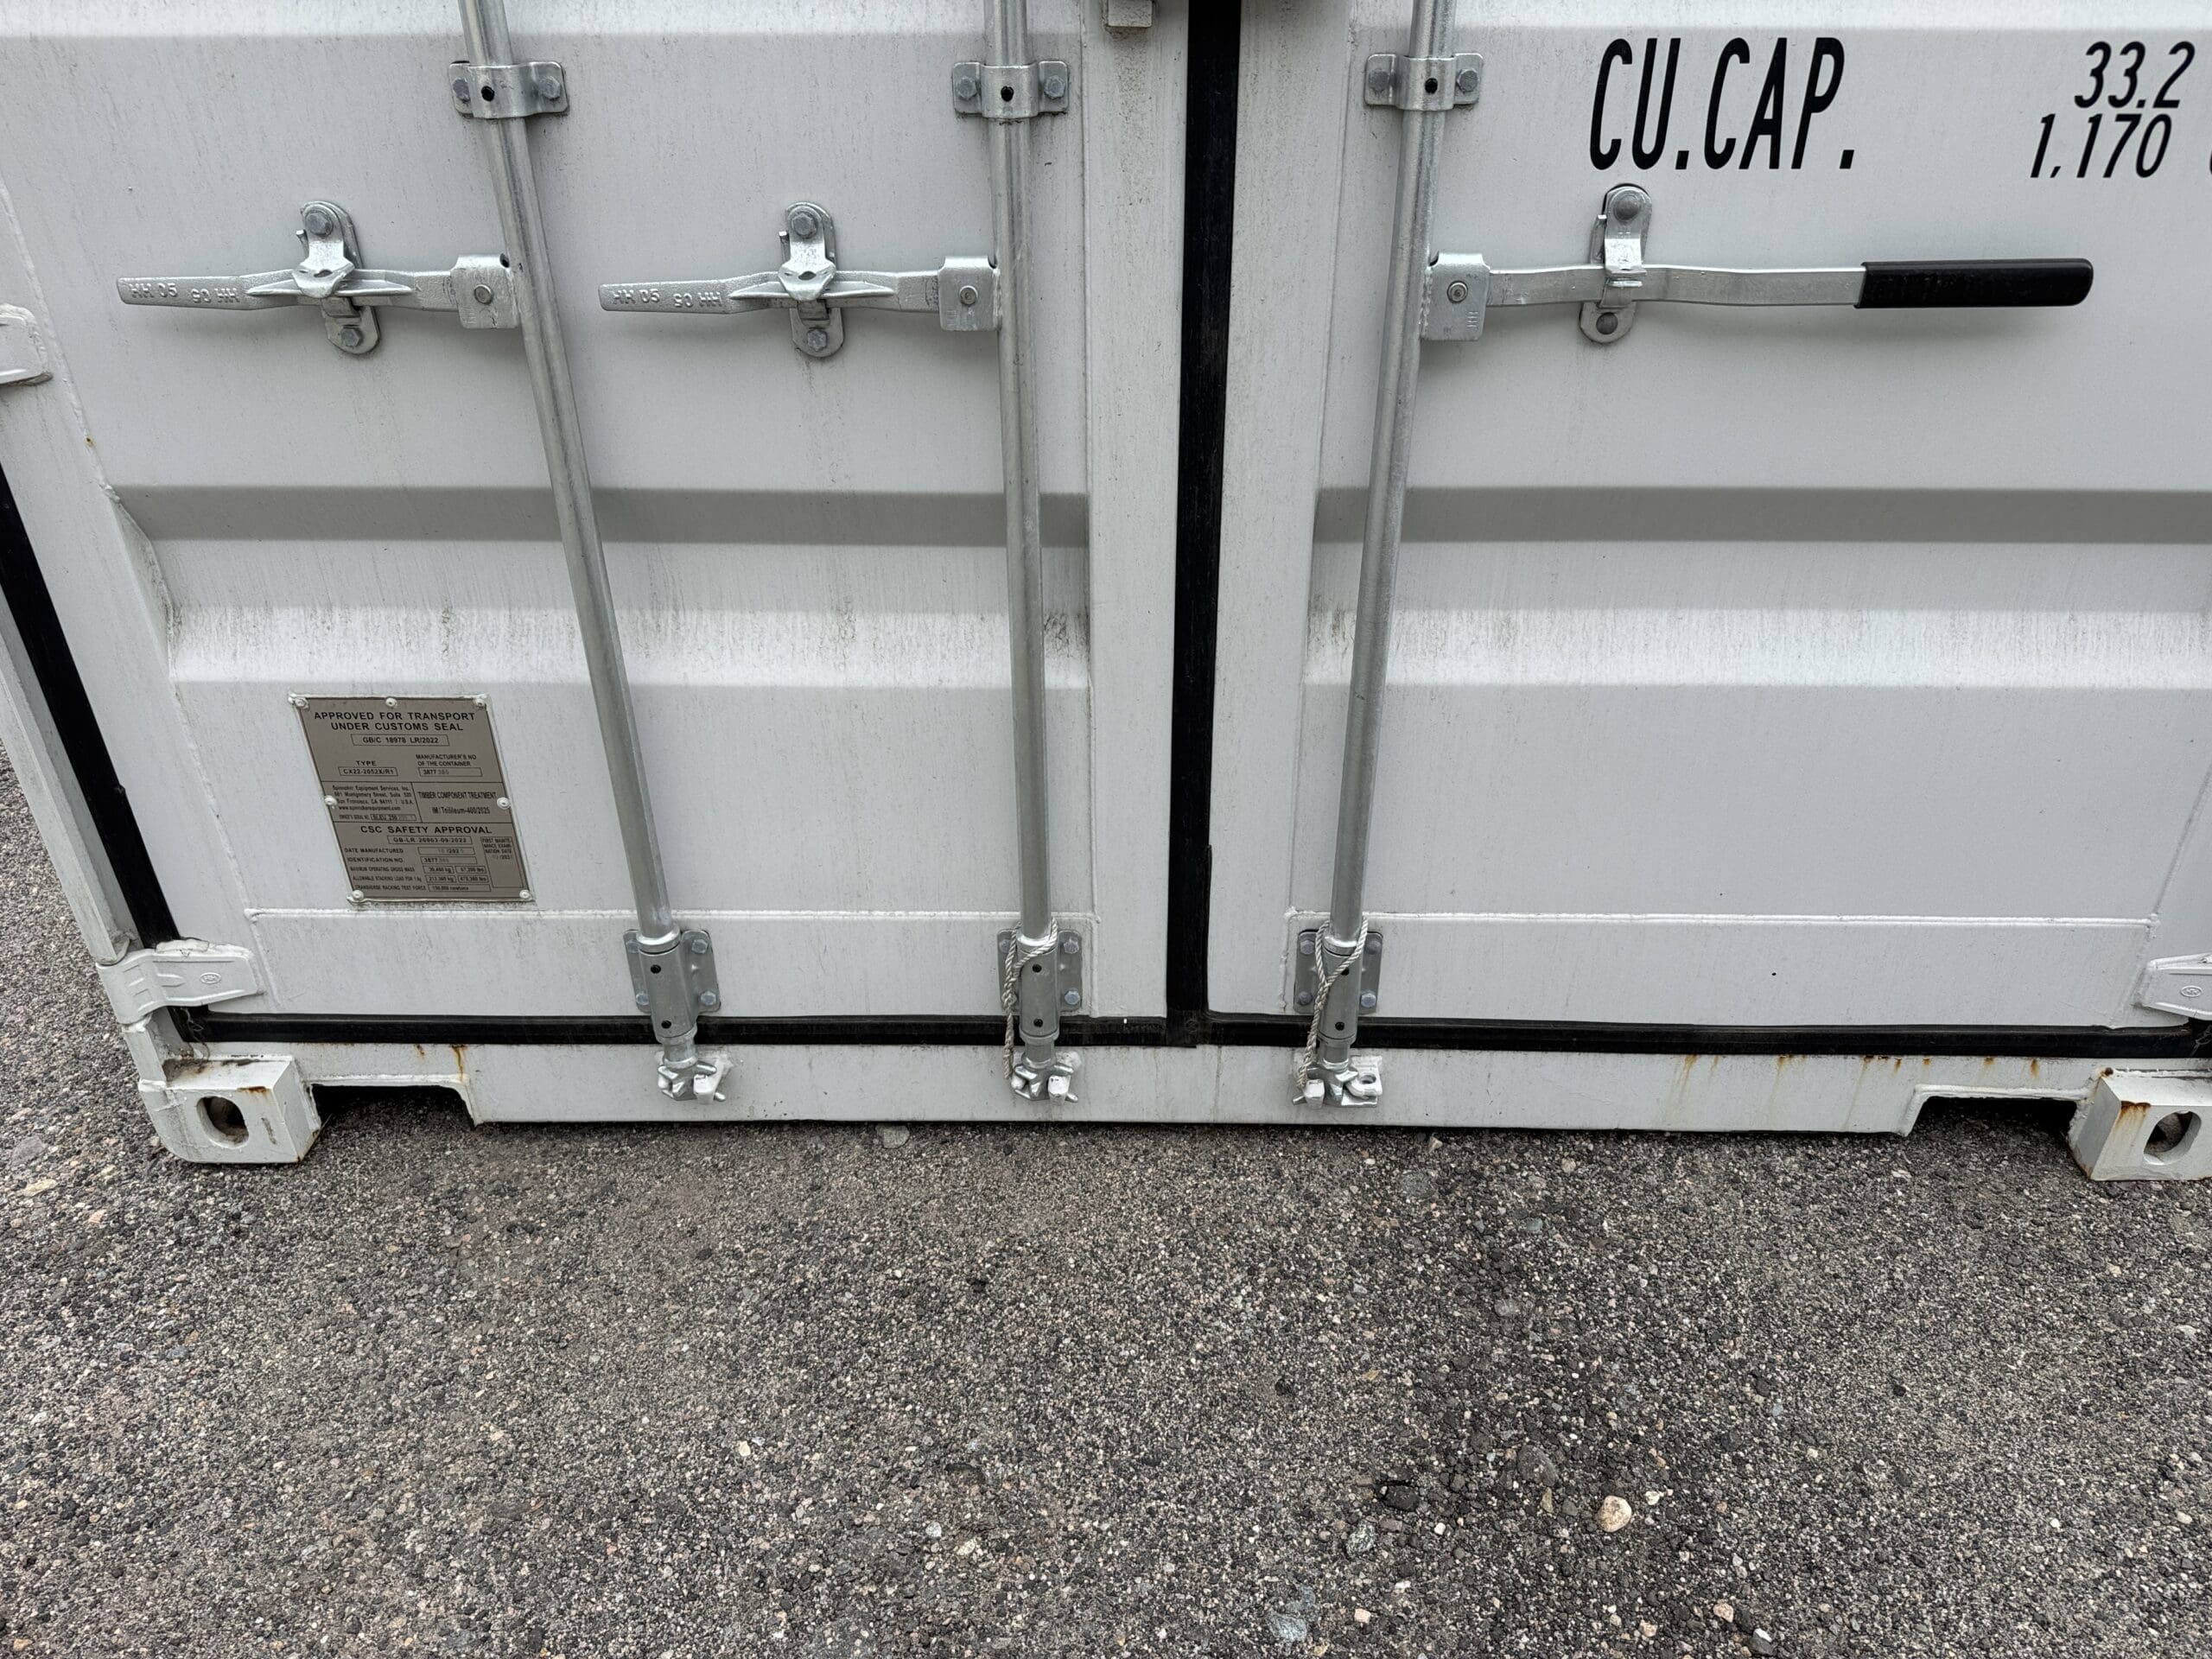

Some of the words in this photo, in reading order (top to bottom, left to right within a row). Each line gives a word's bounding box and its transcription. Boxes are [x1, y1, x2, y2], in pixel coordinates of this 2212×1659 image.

[2075, 41, 2196, 108] 33.2
[1590, 37, 1854, 170] CU.CAP.
[315, 711, 374, 720] APPROVED
[379, 711, 403, 720] FOR
[407, 712, 474, 721] TRANSPORT
[331, 721, 370, 730] UNDER
[374, 722, 429, 731] CUSTOMS
[434, 722, 463, 731] SEAL
[360, 825, 383, 834] CSC
